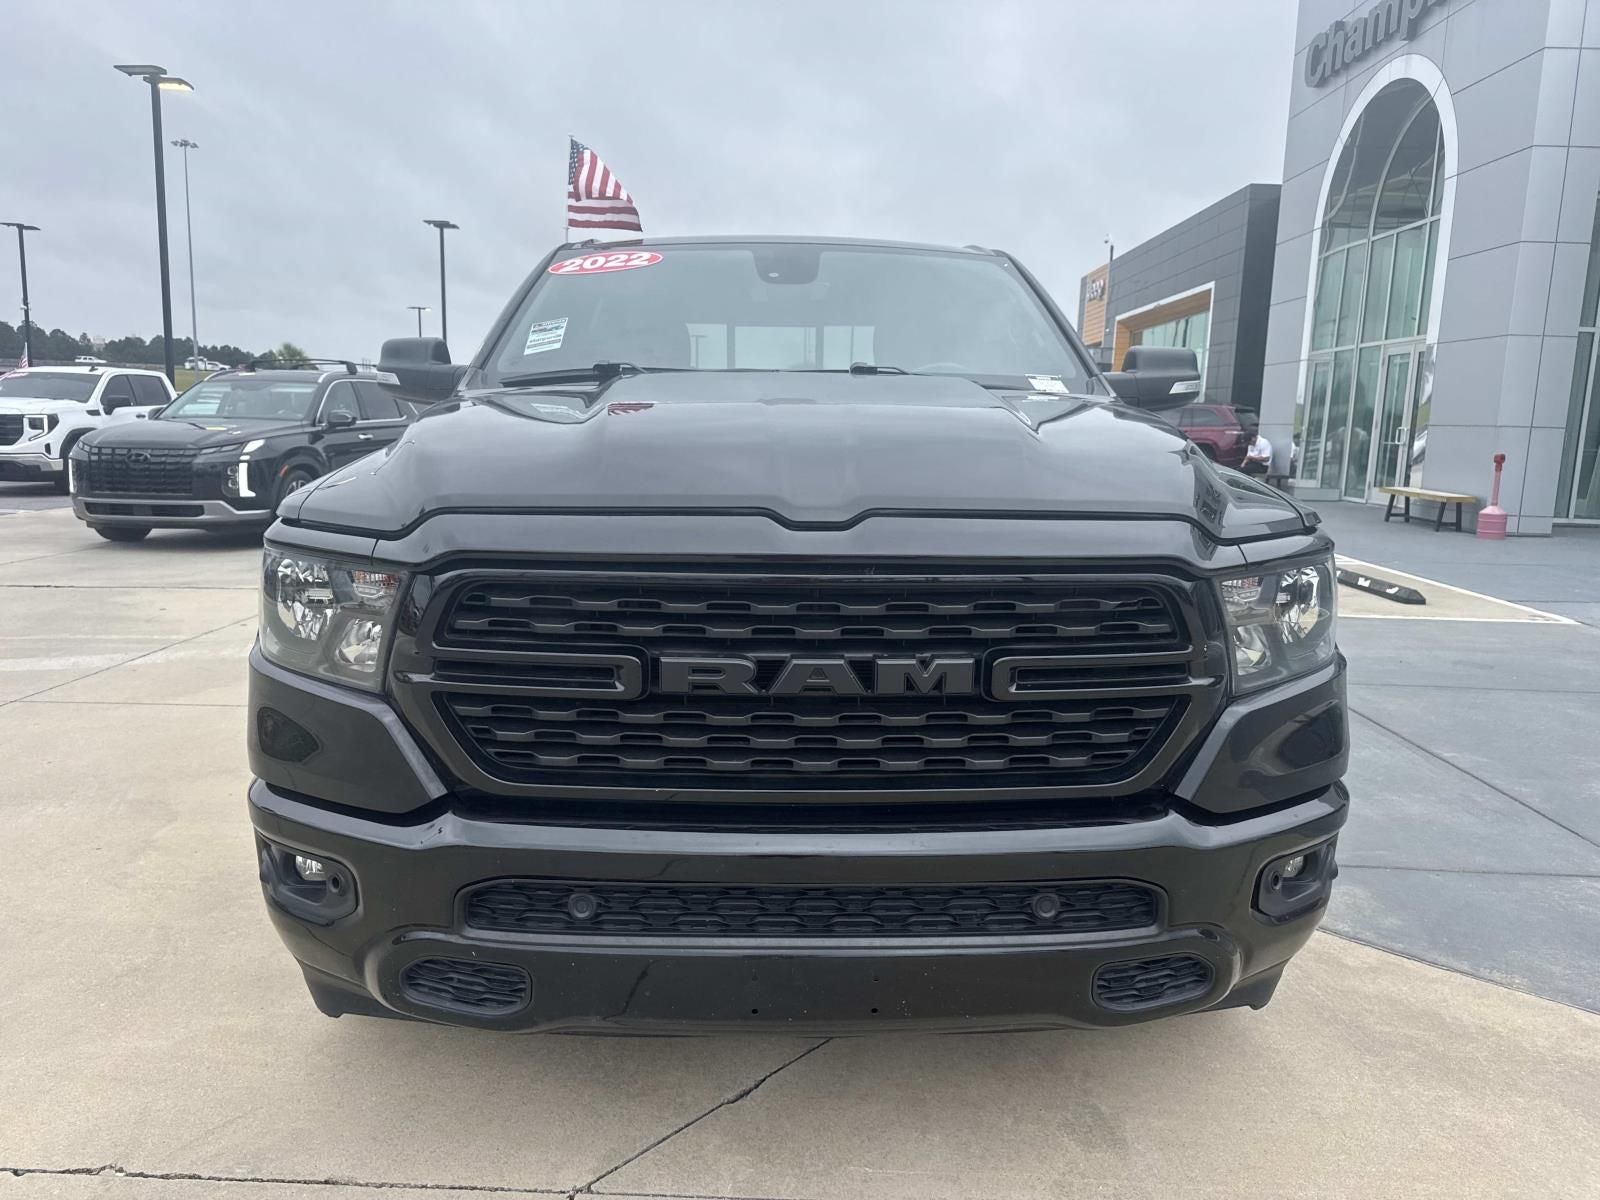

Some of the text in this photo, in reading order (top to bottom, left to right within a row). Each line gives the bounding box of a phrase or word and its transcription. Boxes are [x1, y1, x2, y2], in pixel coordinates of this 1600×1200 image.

[1304, 0, 1437, 88] Champ
[559, 252, 651, 273] 2022
[660, 655, 977, 695] RAM
